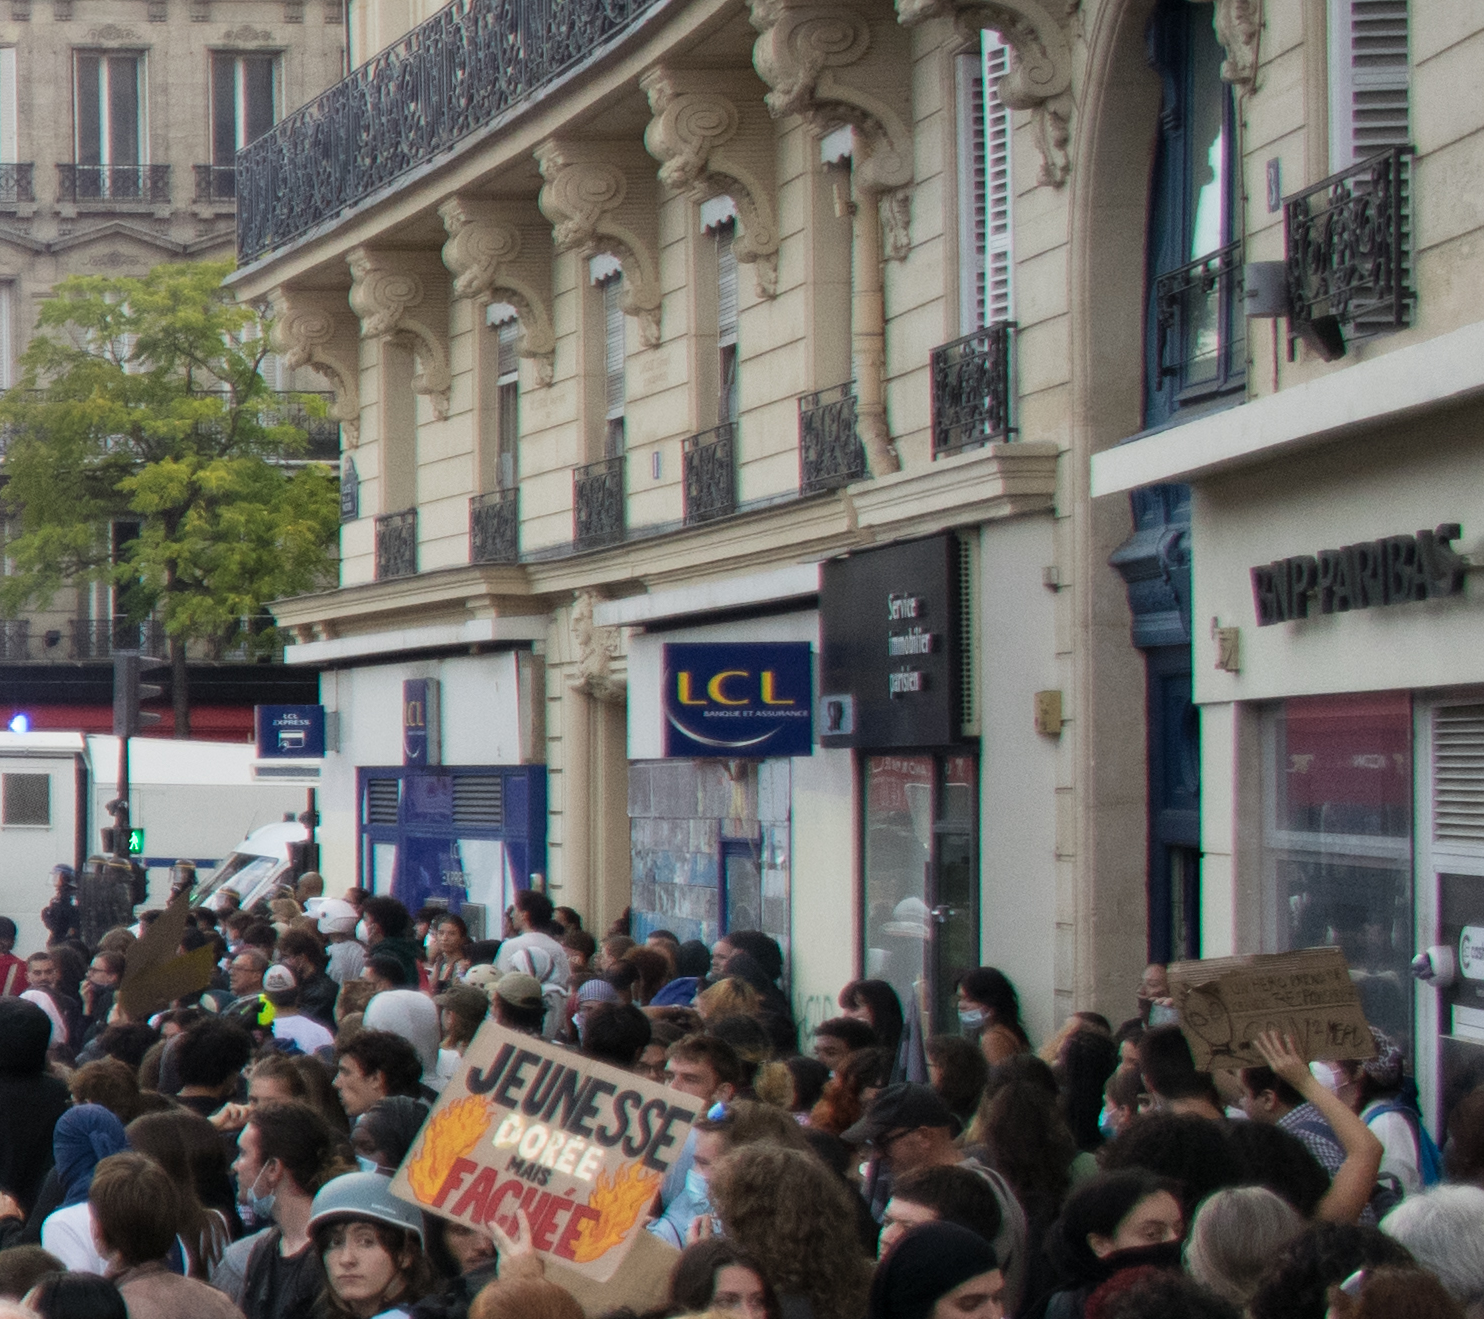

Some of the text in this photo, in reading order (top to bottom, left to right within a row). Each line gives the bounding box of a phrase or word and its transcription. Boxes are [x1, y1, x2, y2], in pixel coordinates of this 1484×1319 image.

[1250, 523, 1467, 627] BNP PARIBAS
[888, 591, 918, 621] Service
[676, 670, 796, 705] LCL
[703, 710, 809, 718] BANQUE ET ASSURANCE
[465, 1042, 696, 1172] JEUNESSE
[491, 1113, 606, 1181] DORÉE
[506, 1155, 552, 1187] MAIS
[431, 1155, 601, 1262] FACHÉE
